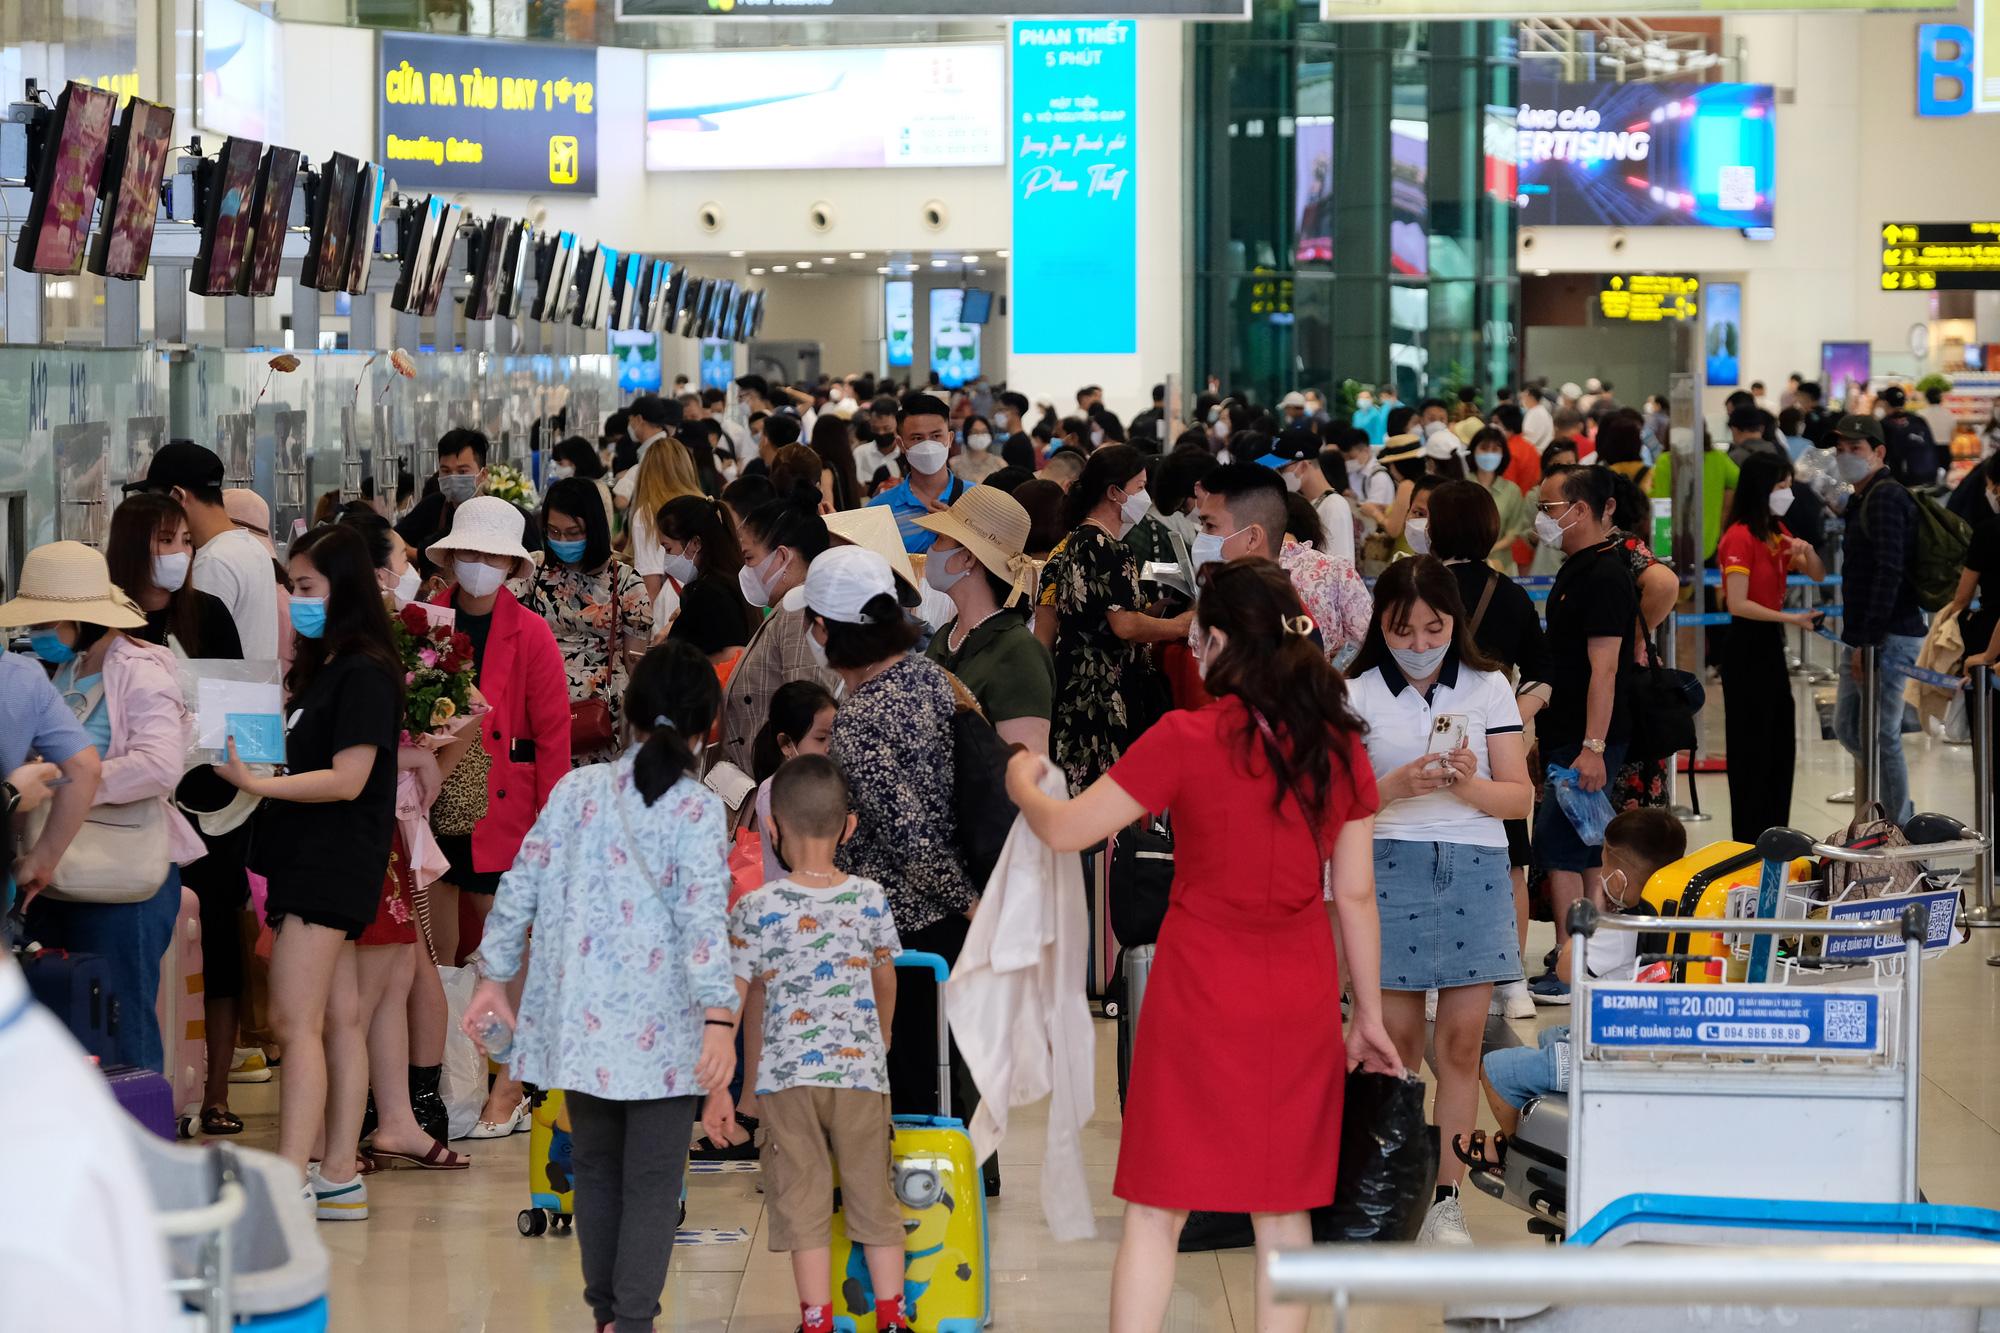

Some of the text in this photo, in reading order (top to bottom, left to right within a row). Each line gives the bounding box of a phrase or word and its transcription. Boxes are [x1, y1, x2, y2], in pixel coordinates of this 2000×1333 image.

[1019, 19, 1129, 46] PHAN THIẾT
[1045, 48, 1103, 67] 5 PHÚT
[1918, 24, 1974, 116] B
[386, 60, 425, 105] CỬA
[429, 73, 457, 106] RA
[460, 68, 498, 109] TÀU
[502, 77, 538, 110] BAY
[1517, 104, 1558, 130] ẢNG
[1517, 130, 1651, 161] ERTISING
[29, 361, 48, 432] A12
[69, 362, 87, 425] A13
[1871, 907, 1895, 921] 20000
[1602, 995, 1658, 1009] BIZMAN
[1681, 996, 1734, 1017] 20.000
[1602, 1023, 1692, 1039] LIÊN HỆ QUẢNG CÁO
